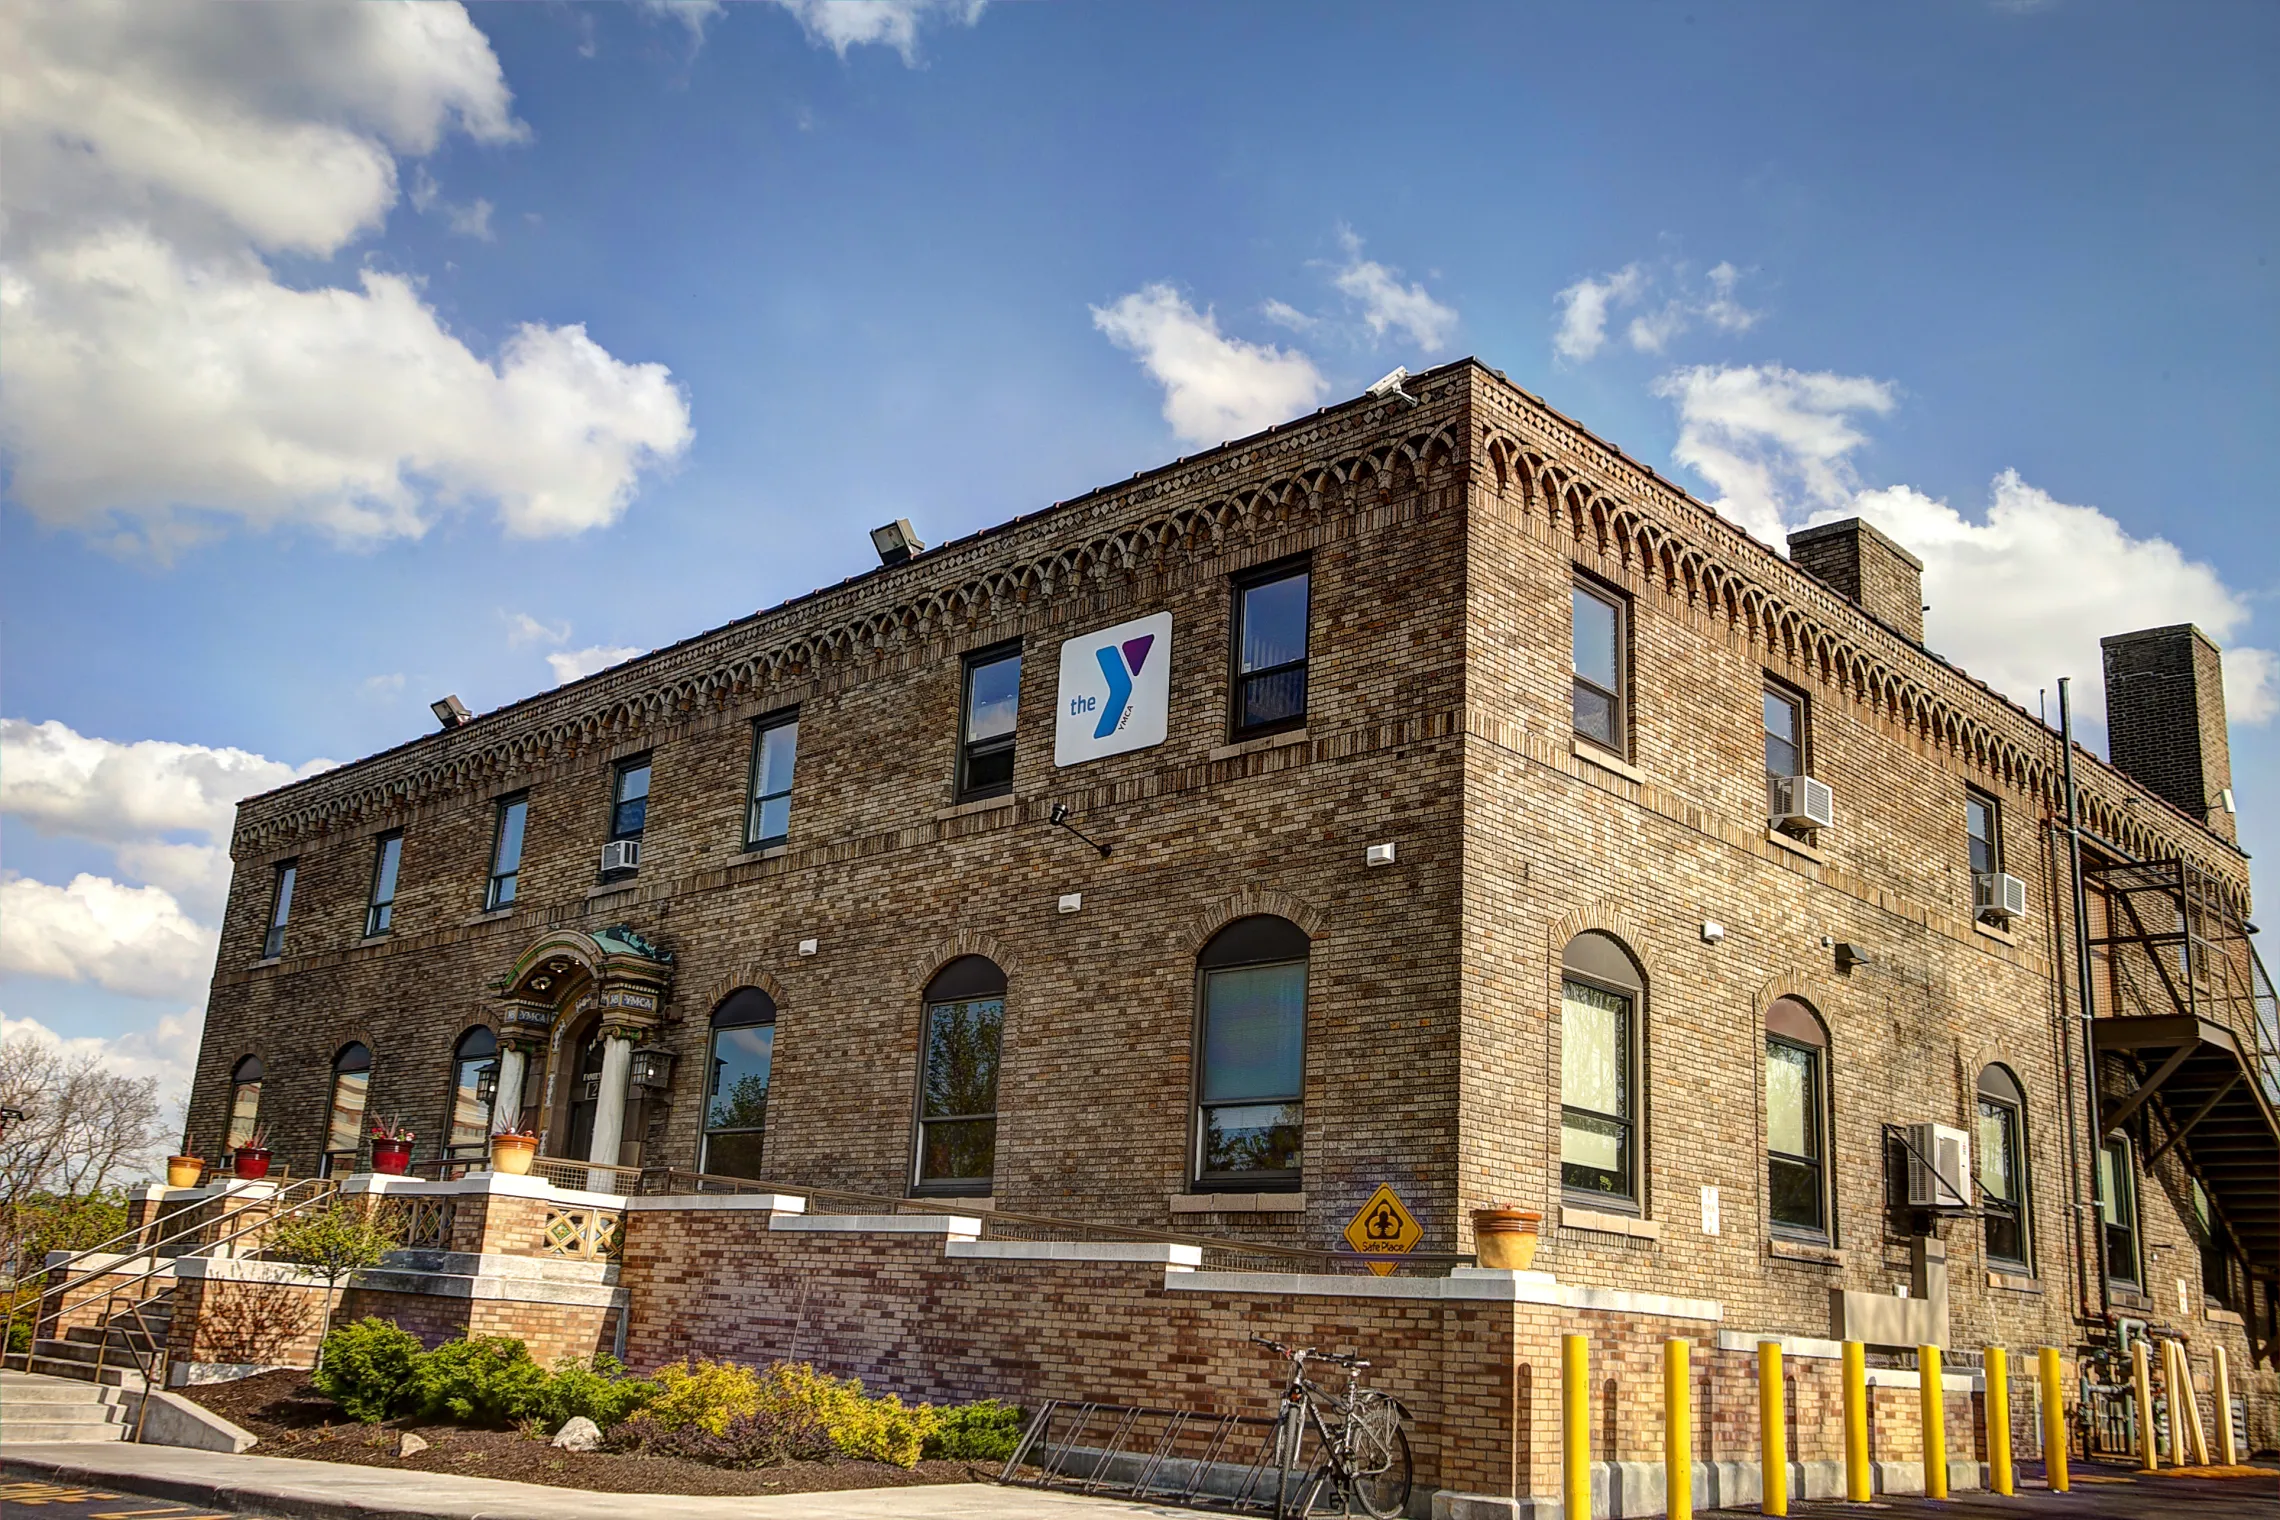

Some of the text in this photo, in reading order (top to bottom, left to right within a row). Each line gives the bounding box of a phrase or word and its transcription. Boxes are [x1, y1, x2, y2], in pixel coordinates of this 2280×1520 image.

[1070, 694, 1096, 716] the
[1118, 705, 1134, 731] YMCA
[623, 994, 652, 1008] YMCA
[519, 1010, 546, 1023] YMCA
[1362, 1241, 1404, 1252] Safe Place
